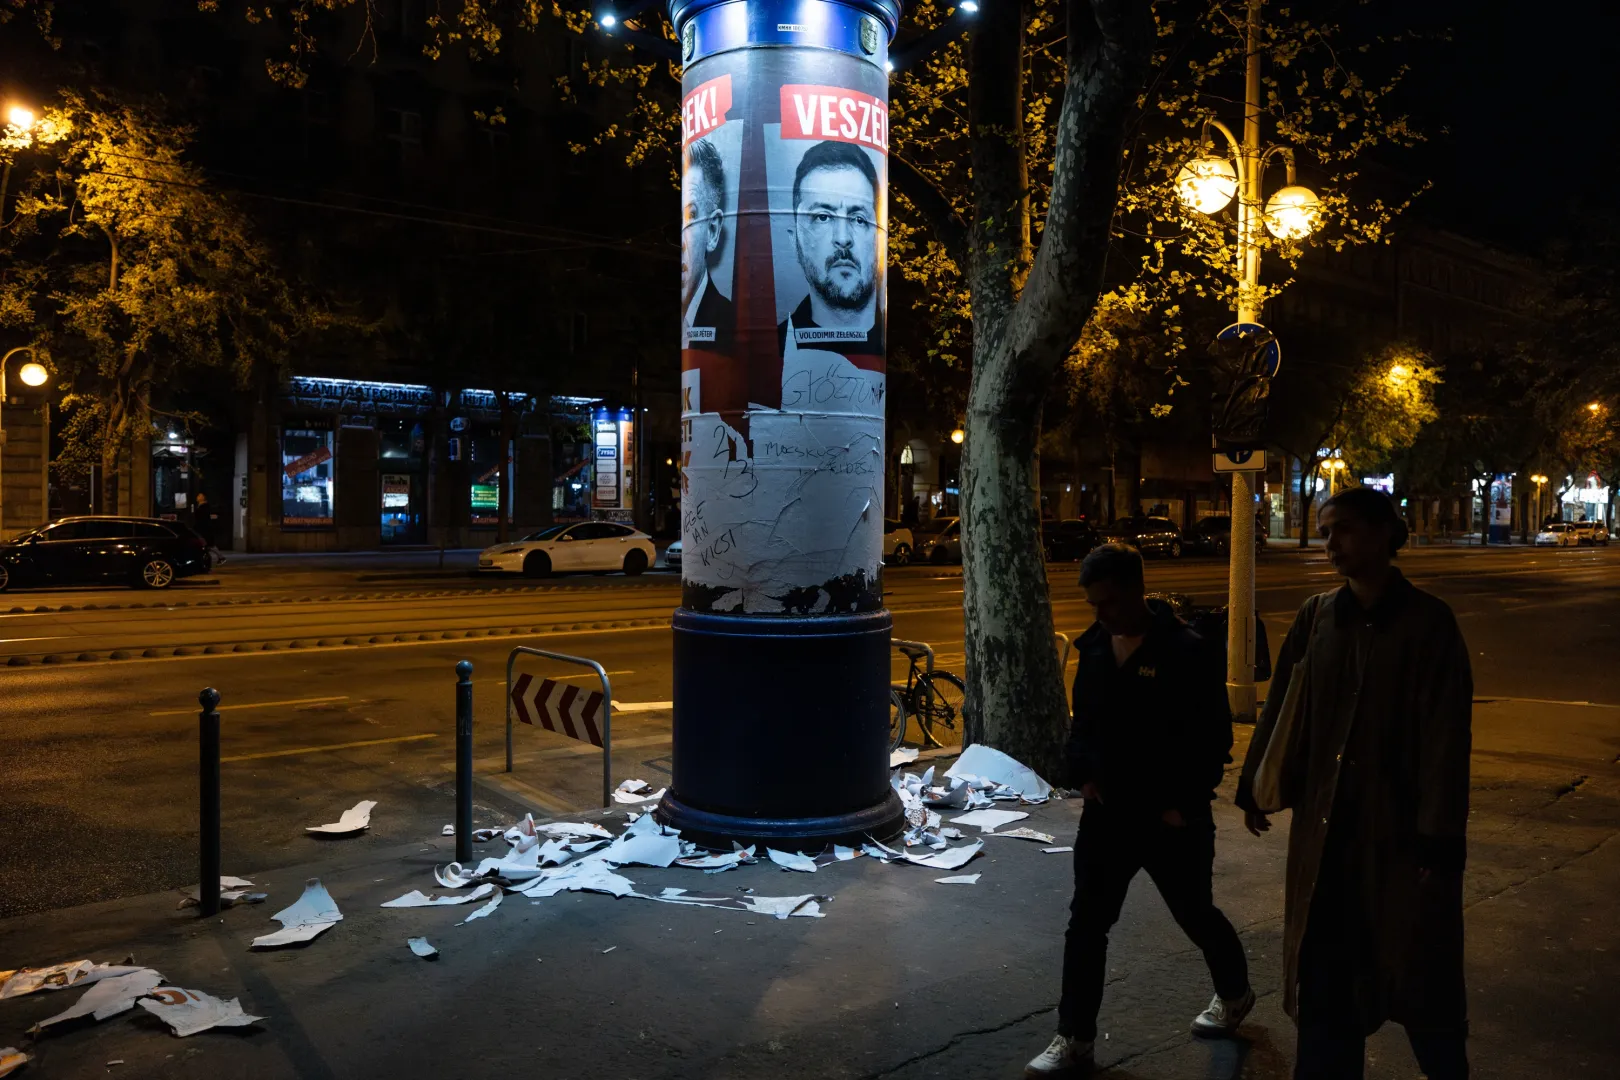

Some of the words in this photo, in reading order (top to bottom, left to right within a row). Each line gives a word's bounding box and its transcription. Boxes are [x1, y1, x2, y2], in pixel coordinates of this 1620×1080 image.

[799, 331, 835, 340] VOLODIMIR
[681, 386, 693, 411] K
[699, 528, 737, 567] KICSI
